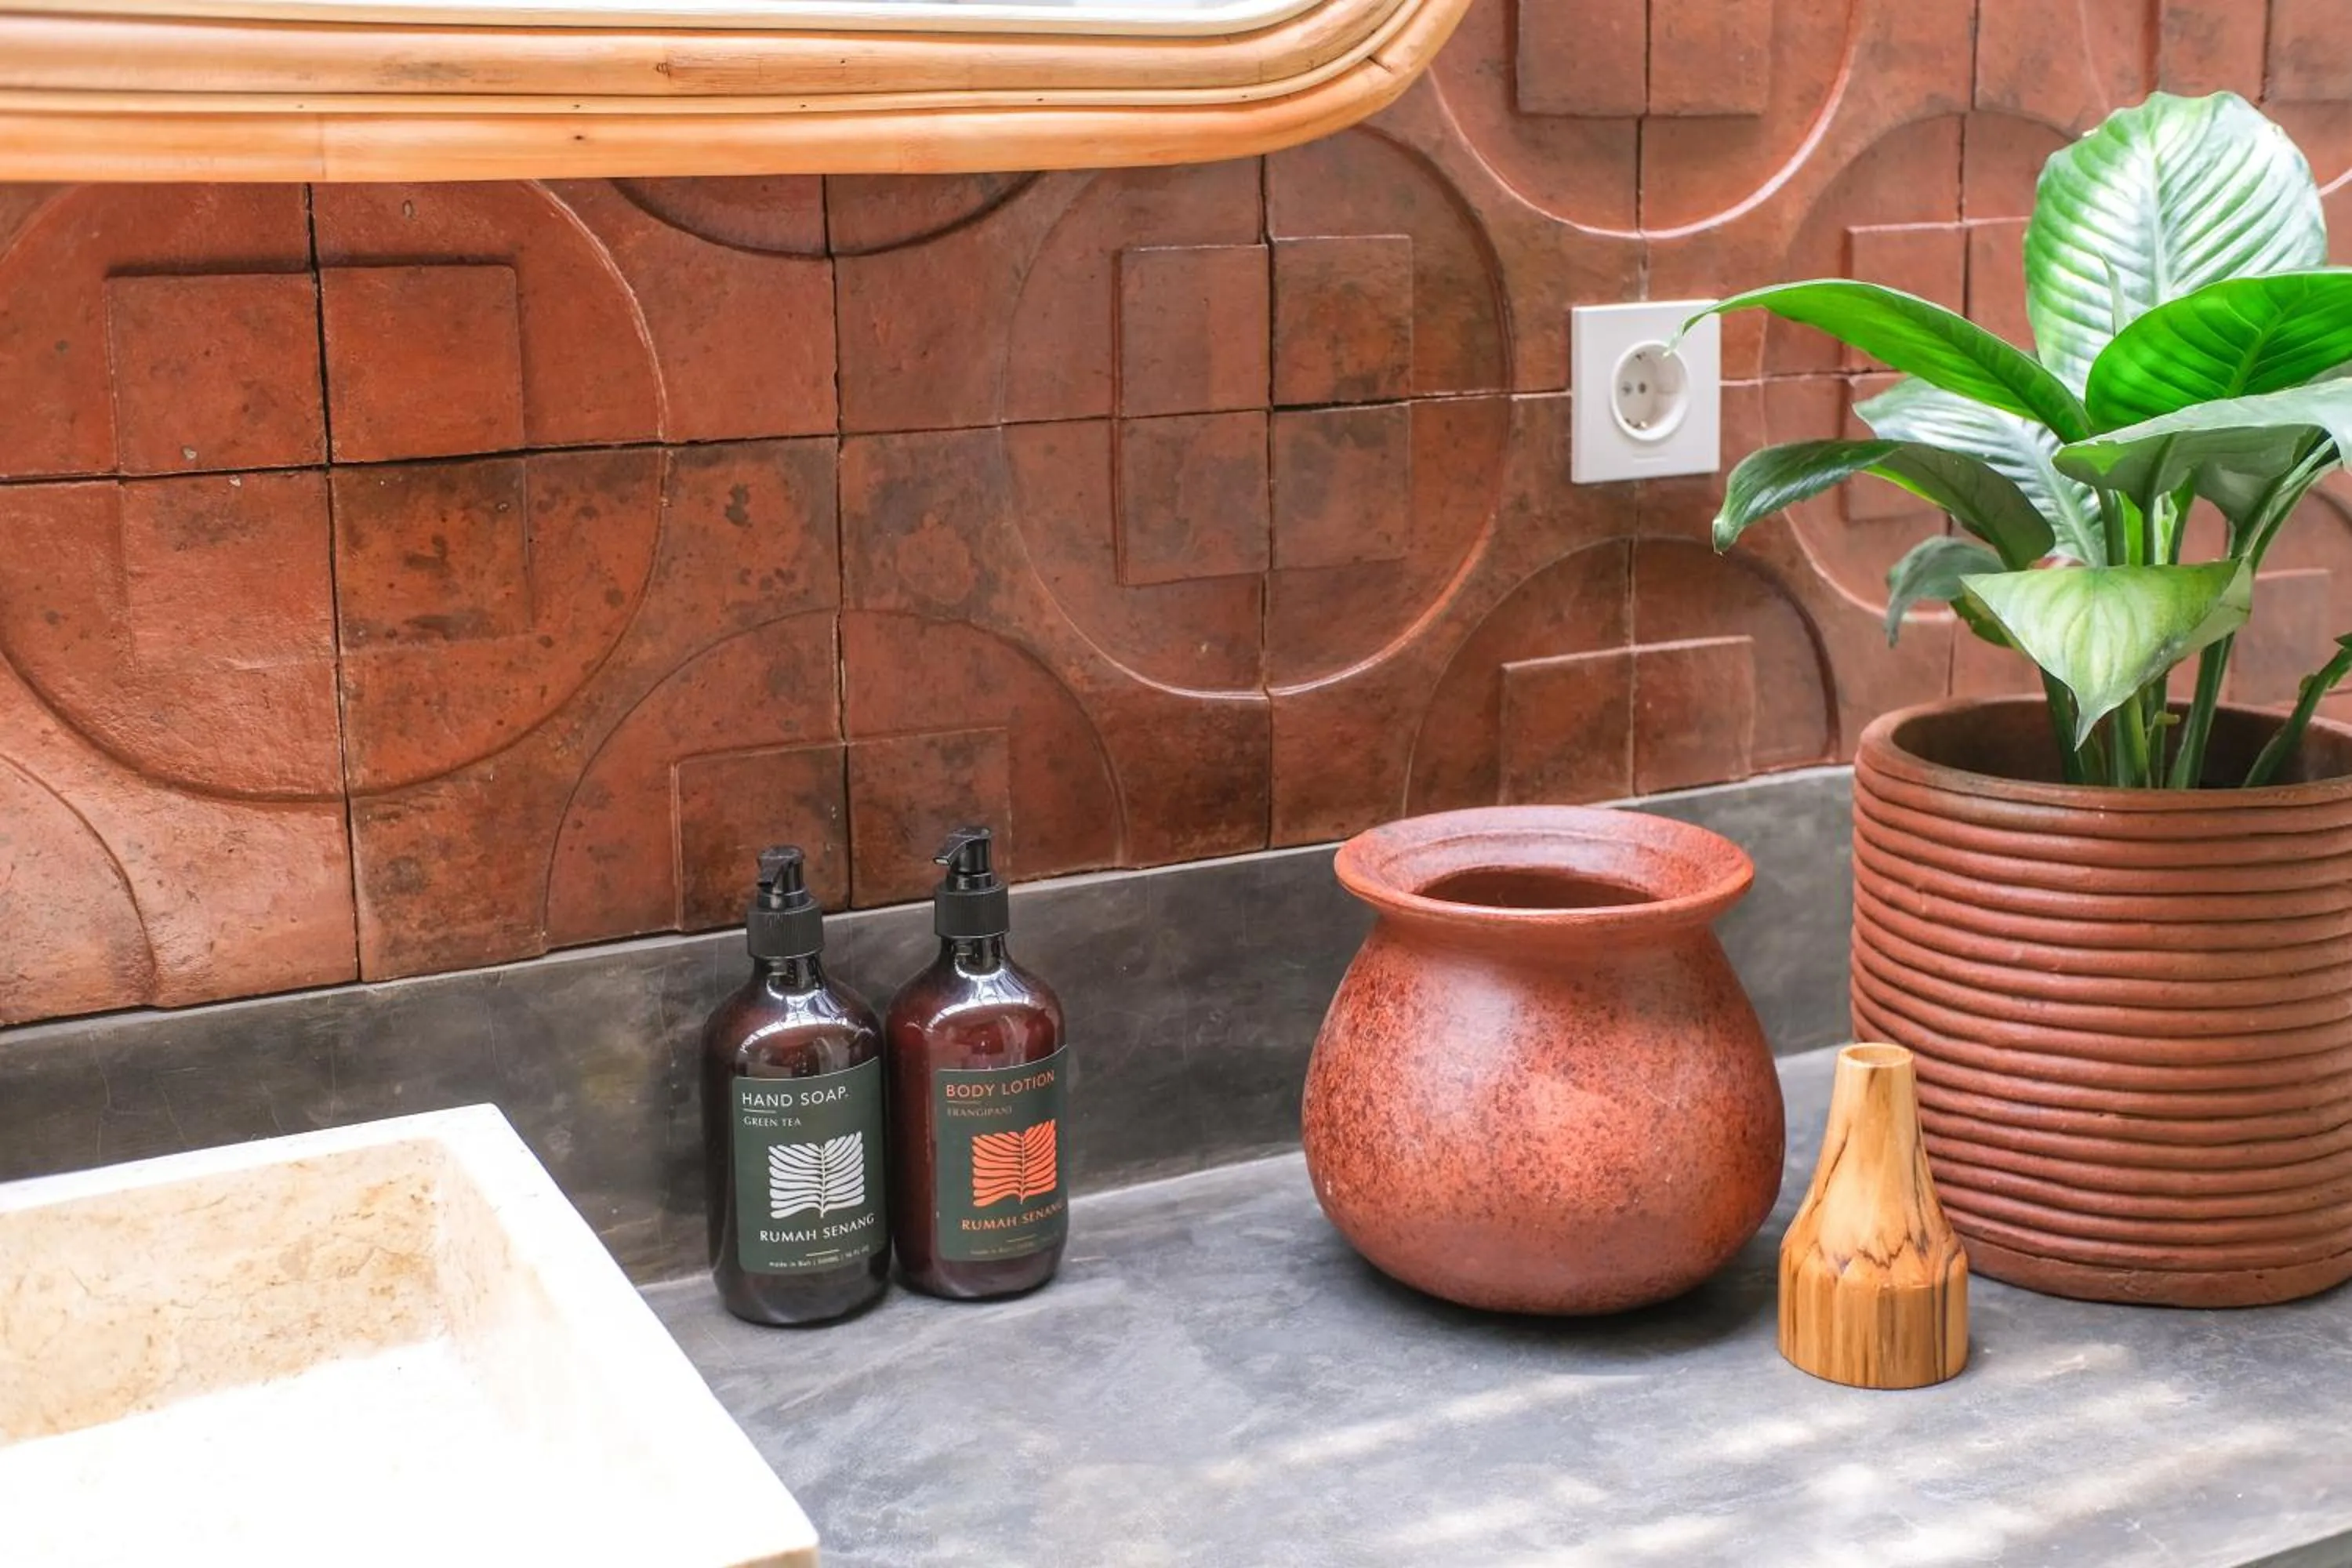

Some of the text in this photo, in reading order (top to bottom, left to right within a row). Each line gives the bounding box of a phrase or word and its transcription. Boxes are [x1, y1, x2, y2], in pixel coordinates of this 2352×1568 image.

[946, 1069, 1055, 1098] BODY LOTION
[742, 1086, 847, 1107] HAND SOAP
[743, 1115, 802, 1127] GREEN TEA
[759, 1212, 875, 1243] RUMAH SENANG
[961, 1215, 1018, 1231] RUMAH
